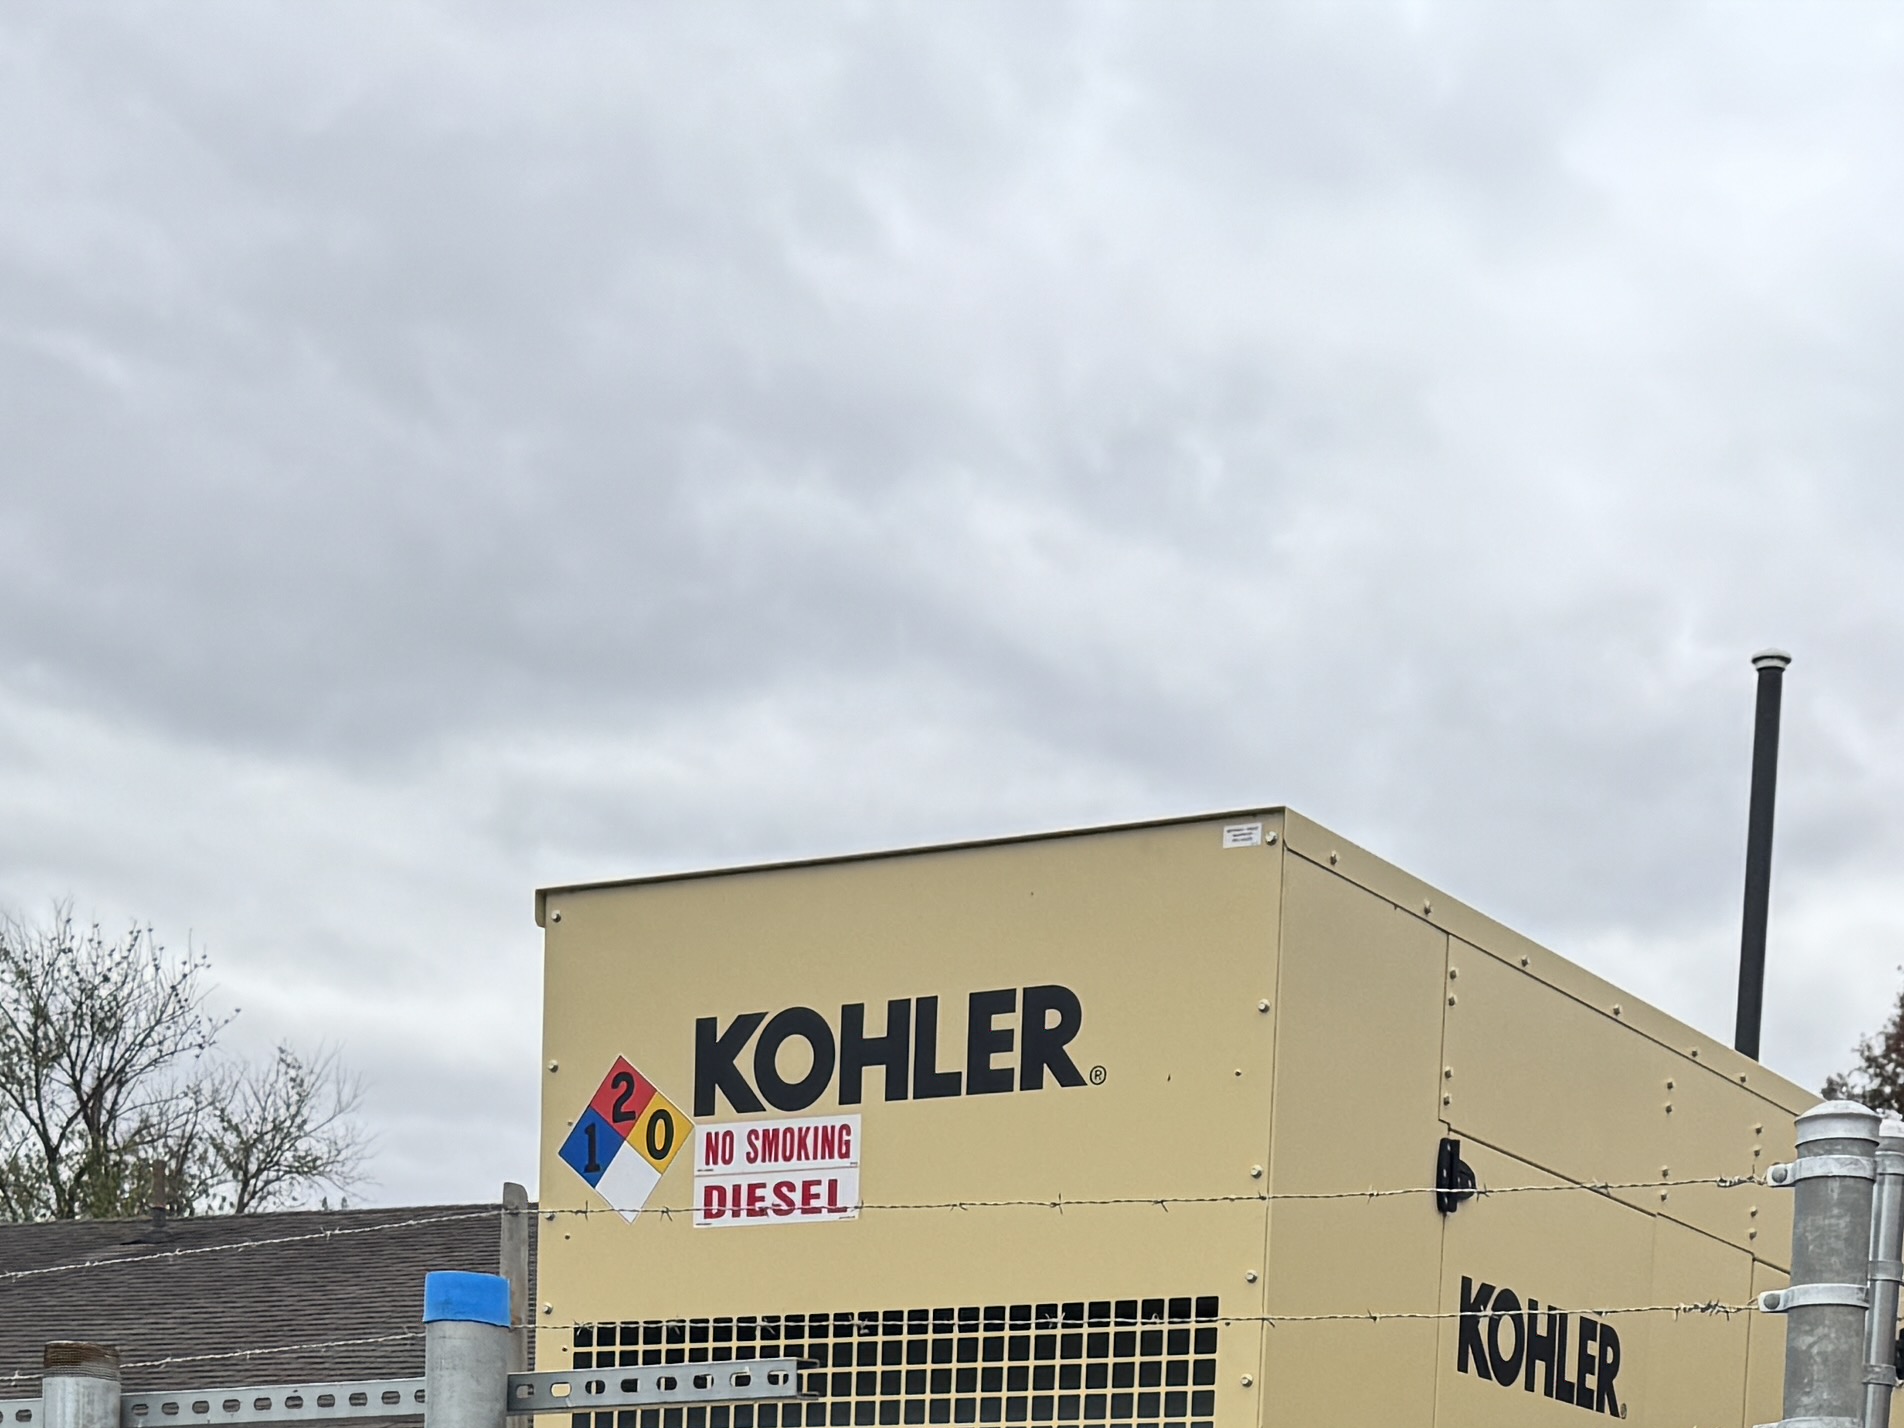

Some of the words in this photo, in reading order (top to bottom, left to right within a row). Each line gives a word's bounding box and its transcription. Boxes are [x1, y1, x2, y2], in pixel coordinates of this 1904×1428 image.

[611, 1071, 636, 1123] 2
[584, 1123, 600, 1173] 1
[646, 1109, 674, 1160] 0
[705, 1130, 734, 1166] NO
[746, 1123, 851, 1164] SMOKING
[704, 1179, 847, 1219] DIESEL
